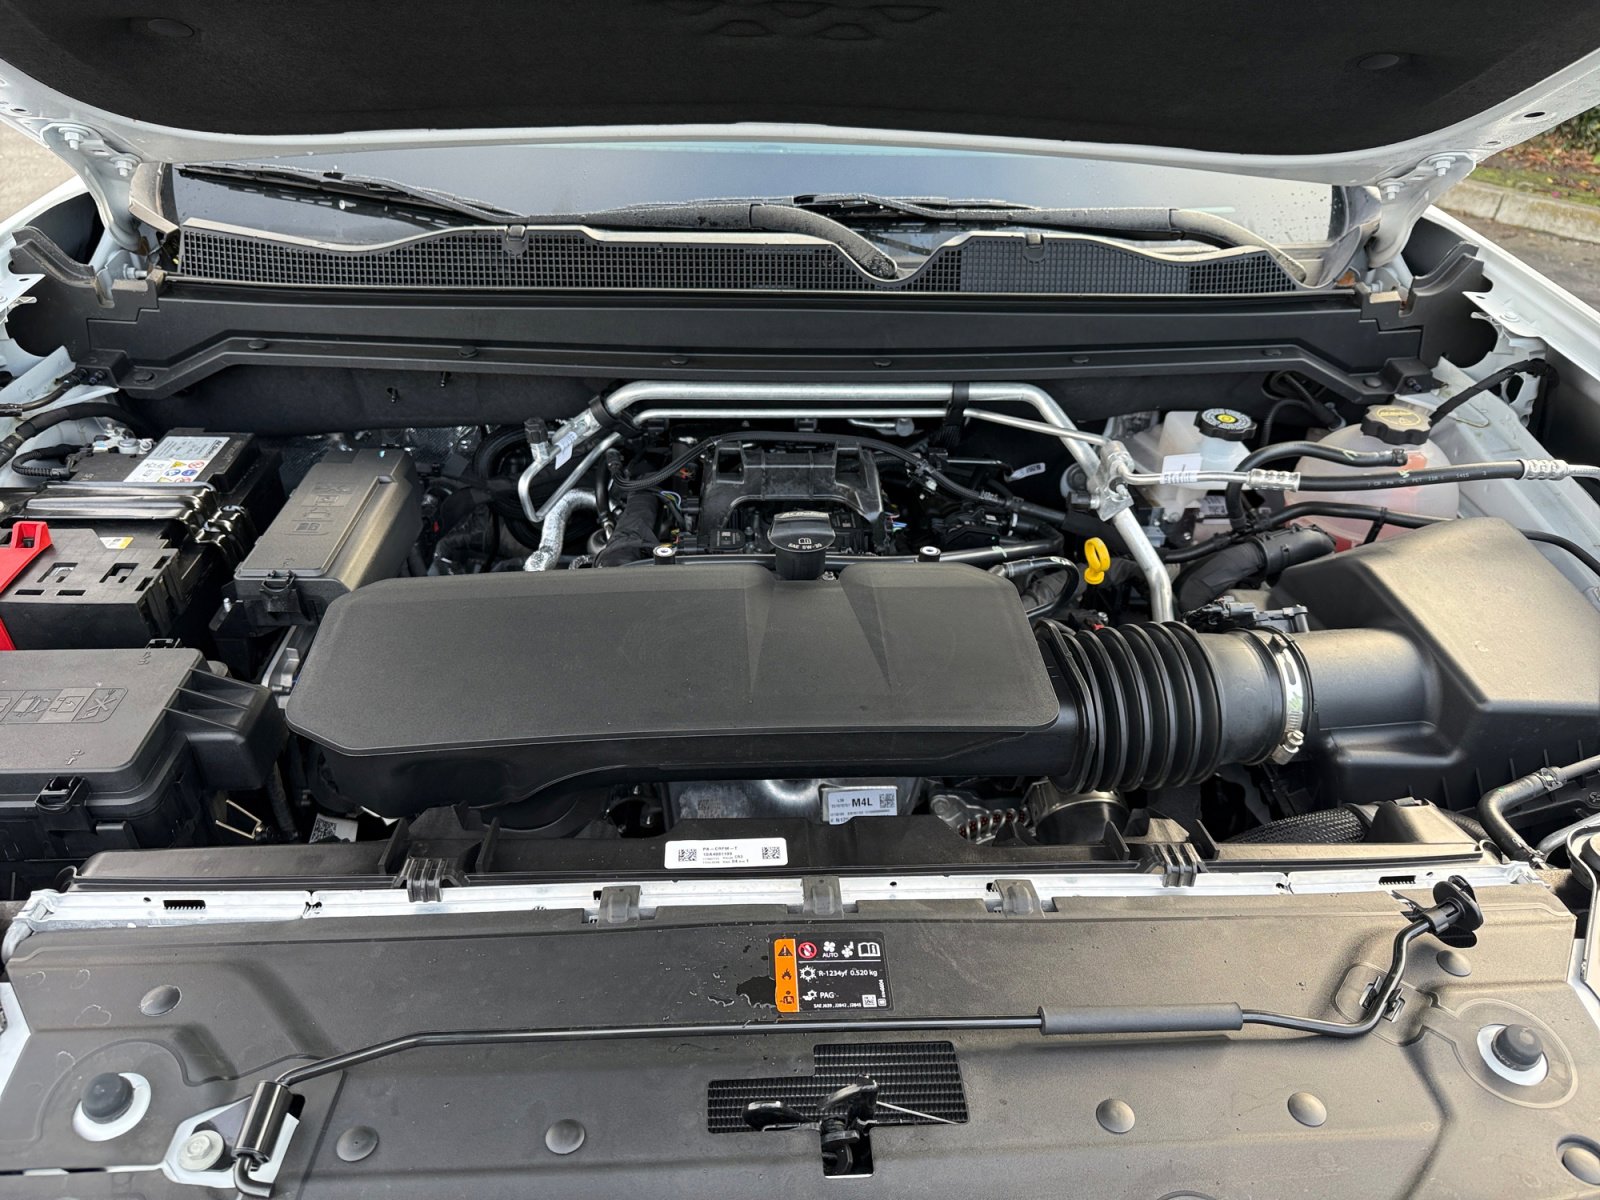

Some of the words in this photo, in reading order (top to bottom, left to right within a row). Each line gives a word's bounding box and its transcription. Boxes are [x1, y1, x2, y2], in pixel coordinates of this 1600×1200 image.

[851, 797, 873, 807] M4L
[818, 969, 848, 978] R-1234yf
[869, 969, 878, 977] kg
